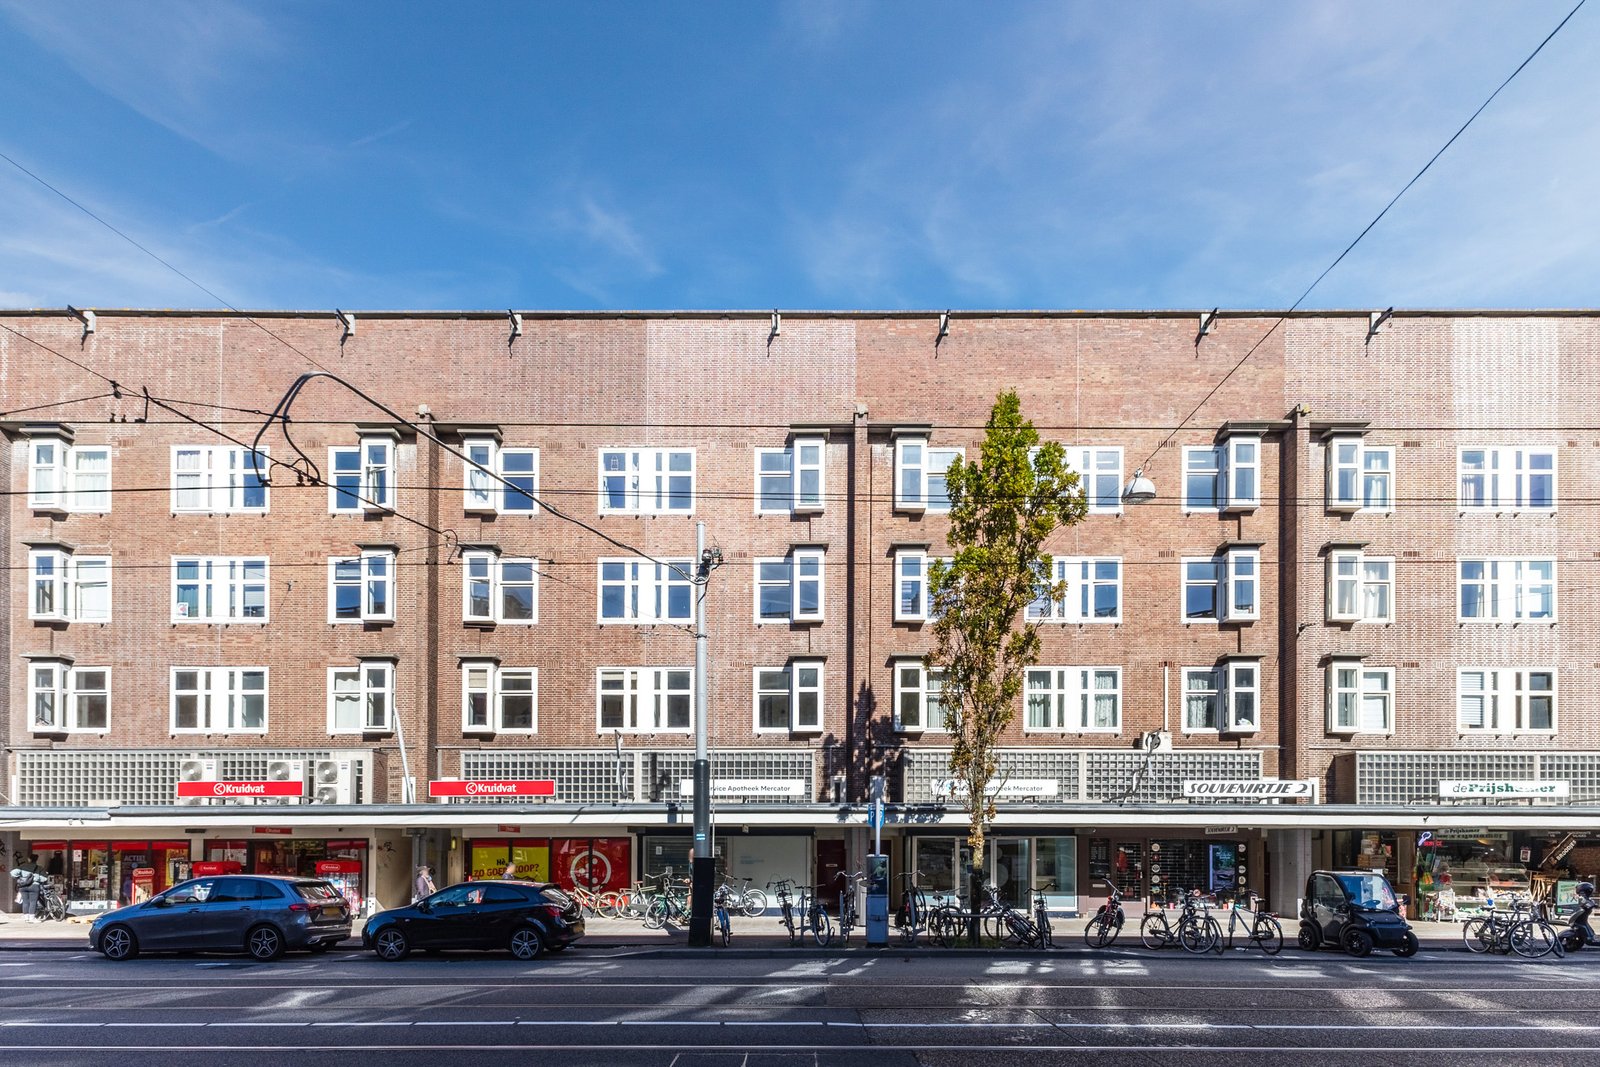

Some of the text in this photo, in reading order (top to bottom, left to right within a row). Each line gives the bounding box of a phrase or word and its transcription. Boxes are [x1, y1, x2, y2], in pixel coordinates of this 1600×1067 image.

[226, 784, 265, 793] Kruidvat
[478, 783, 517, 793] Kruidvat
[728, 785, 759, 793] Apotheek
[1188, 783, 1308, 794] SOUVENIRTJE 2
